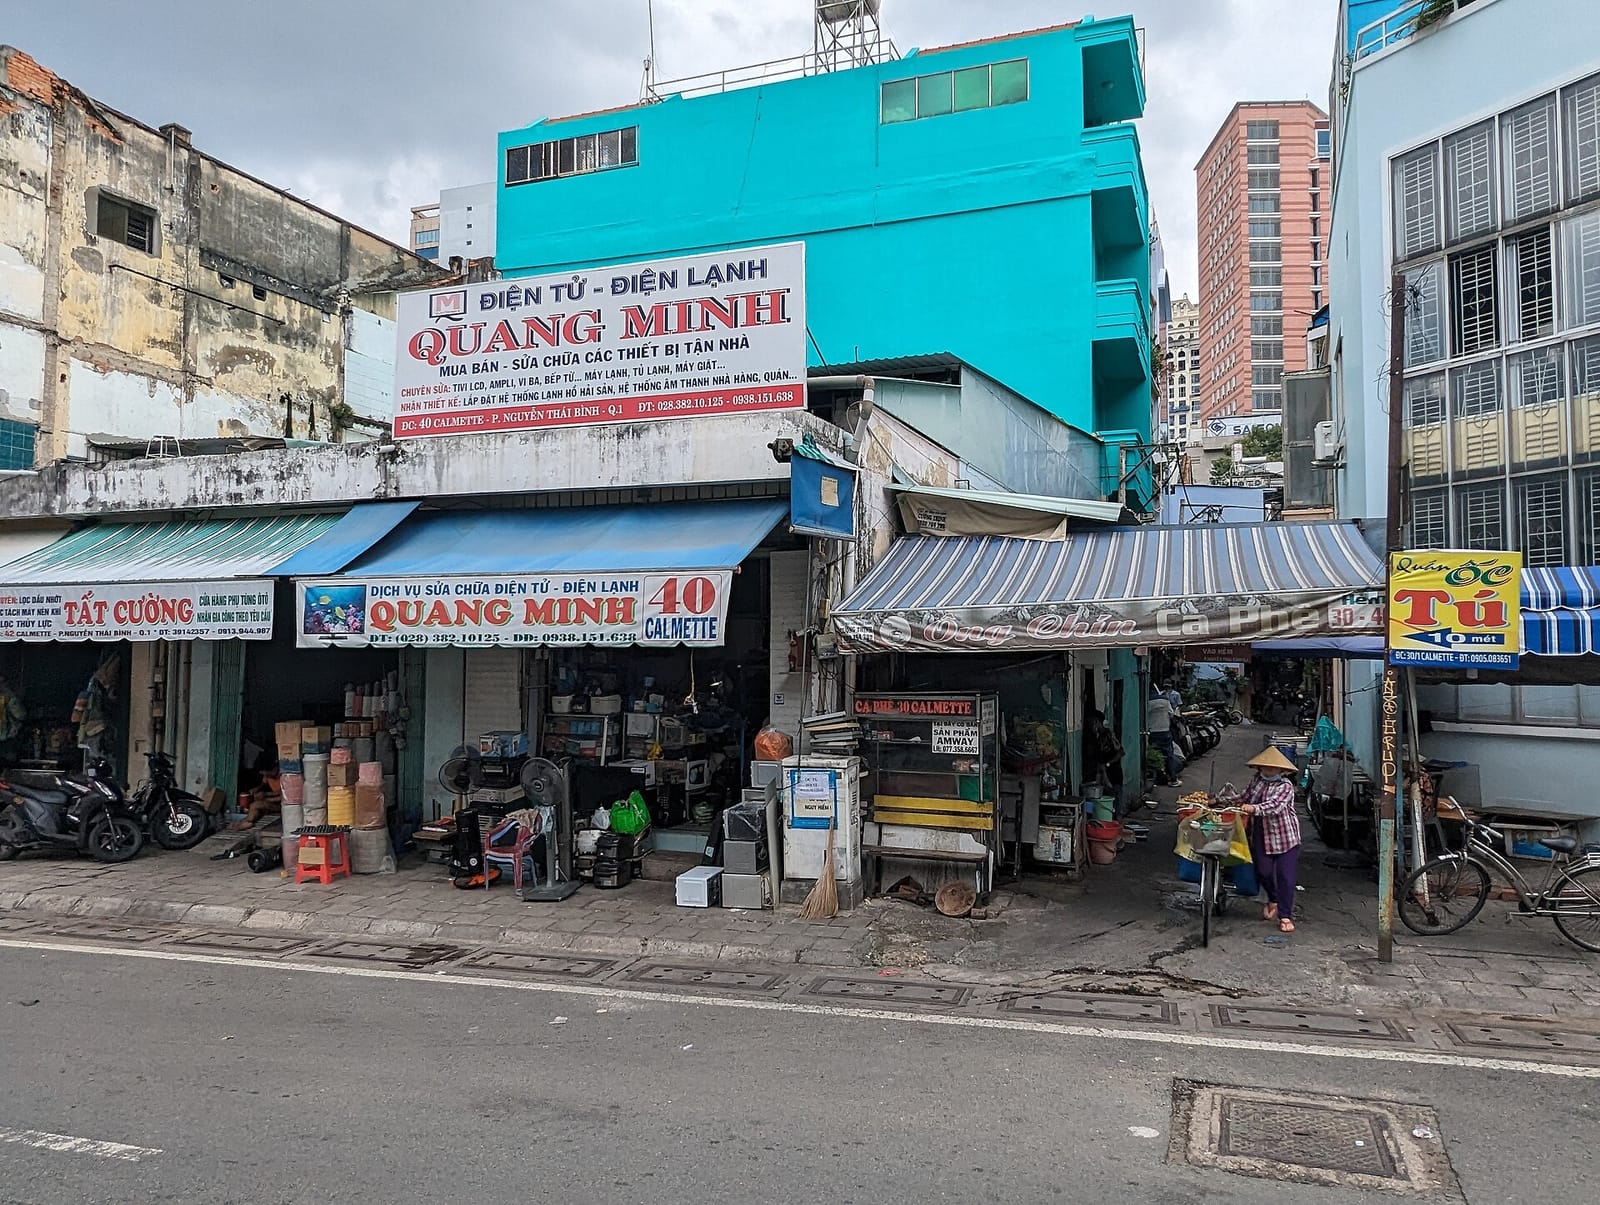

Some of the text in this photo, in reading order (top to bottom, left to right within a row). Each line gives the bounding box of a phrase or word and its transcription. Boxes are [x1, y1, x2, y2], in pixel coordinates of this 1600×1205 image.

[480, 258, 768, 312] ĐIỆN TỬ - ĐIỆN LẠNH
[408, 288, 791, 366] QUANG MINH
[439, 364, 467, 378] MUA
[472, 358, 499, 375] BÁN
[512, 354, 538, 371] SỬA
[543, 351, 580, 368] CHỮA
[585, 346, 612, 364] CÁC
[618, 341, 660, 361] THIẾT
[664, 343, 680, 358] BỊ
[684, 338, 714, 356] TẬN
[719, 333, 750, 352] NHÀ
[400, 400, 421, 412] NHẬN
[424, 396, 446, 409] THIẾT
[512, 389, 539, 402] THỐNG
[542, 389, 563, 401] LẠNH
[580, 384, 594, 396] HẢI
[633, 378, 662, 392] THỐNG
[664, 378, 678, 390] ÂM
[680, 376, 709, 389] THANH
[712, 373, 730, 386] NHÀ
[734, 371, 761, 383] HÀNG,
[401, 384, 431, 398] CHUYÊN
[453, 382, 467, 392] TIVI
[470, 382, 487, 391] LCD,
[490, 379, 516, 390] AMPLI,
[518, 378, 526, 386] VI
[528, 377, 542, 386] BA,
[545, 372, 561, 384] BẾP
[585, 369, 603, 381] MÁY
[606, 368, 630, 381] LẠNH,
[633, 364, 644, 376] TỦ
[647, 364, 673, 376] LẠNH,
[676, 361, 694, 373] MÁY
[401, 421, 417, 431] ĐC:
[419, 417, 431, 428] 40
[433, 415, 484, 427] CALMETTE
[492, 414, 501, 424] P.
[503, 407, 544, 422] NGUYỄN
[546, 407, 571, 419] THÁI
[574, 405, 600, 417] BÌNH
[608, 405, 623, 416] Q.1
[638, 402, 655, 412] ĐT:
[658, 397, 724, 412] 028.382.10.125
[733, 391, 793, 405] 0938.151.638
[1397, 557, 1451, 573] Quán
[371, 586, 400, 599] DỊCH
[405, 585, 421, 598] VỤ
[425, 581, 450, 595] SỬA
[455, 581, 490, 595] CHỮA
[494, 579, 526, 596] ĐIỆN
[531, 578, 551, 594] TỬ
[563, 579, 596, 596] ĐIỆN
[601, 580, 639, 595] LẠNH
[648, 577, 716, 615] 40
[64, 590, 195, 627] TẤT CƯỜNG
[212, 612, 221, 622] GIA
[236, 612, 249, 622] THEO
[370, 596, 637, 632] QUANG MINH
[1394, 589, 1510, 628] Tú
[172, 628, 210, 636] 39142357
[396, 634, 428, 644] (028)
[432, 634, 500, 642] 382.10125
[543, 633, 637, 642] 0938.151.638
[645, 617, 718, 639] CALMETTE
[924, 613, 1142, 646] Ông Chín
[1428, 633, 1466, 643] 10
[1421, 652, 1454, 661] CALMETTE
[911, 700, 971, 714] CALMETTE
[934, 728, 950, 736] SẢN
[937, 737, 973, 745] AMWAY
